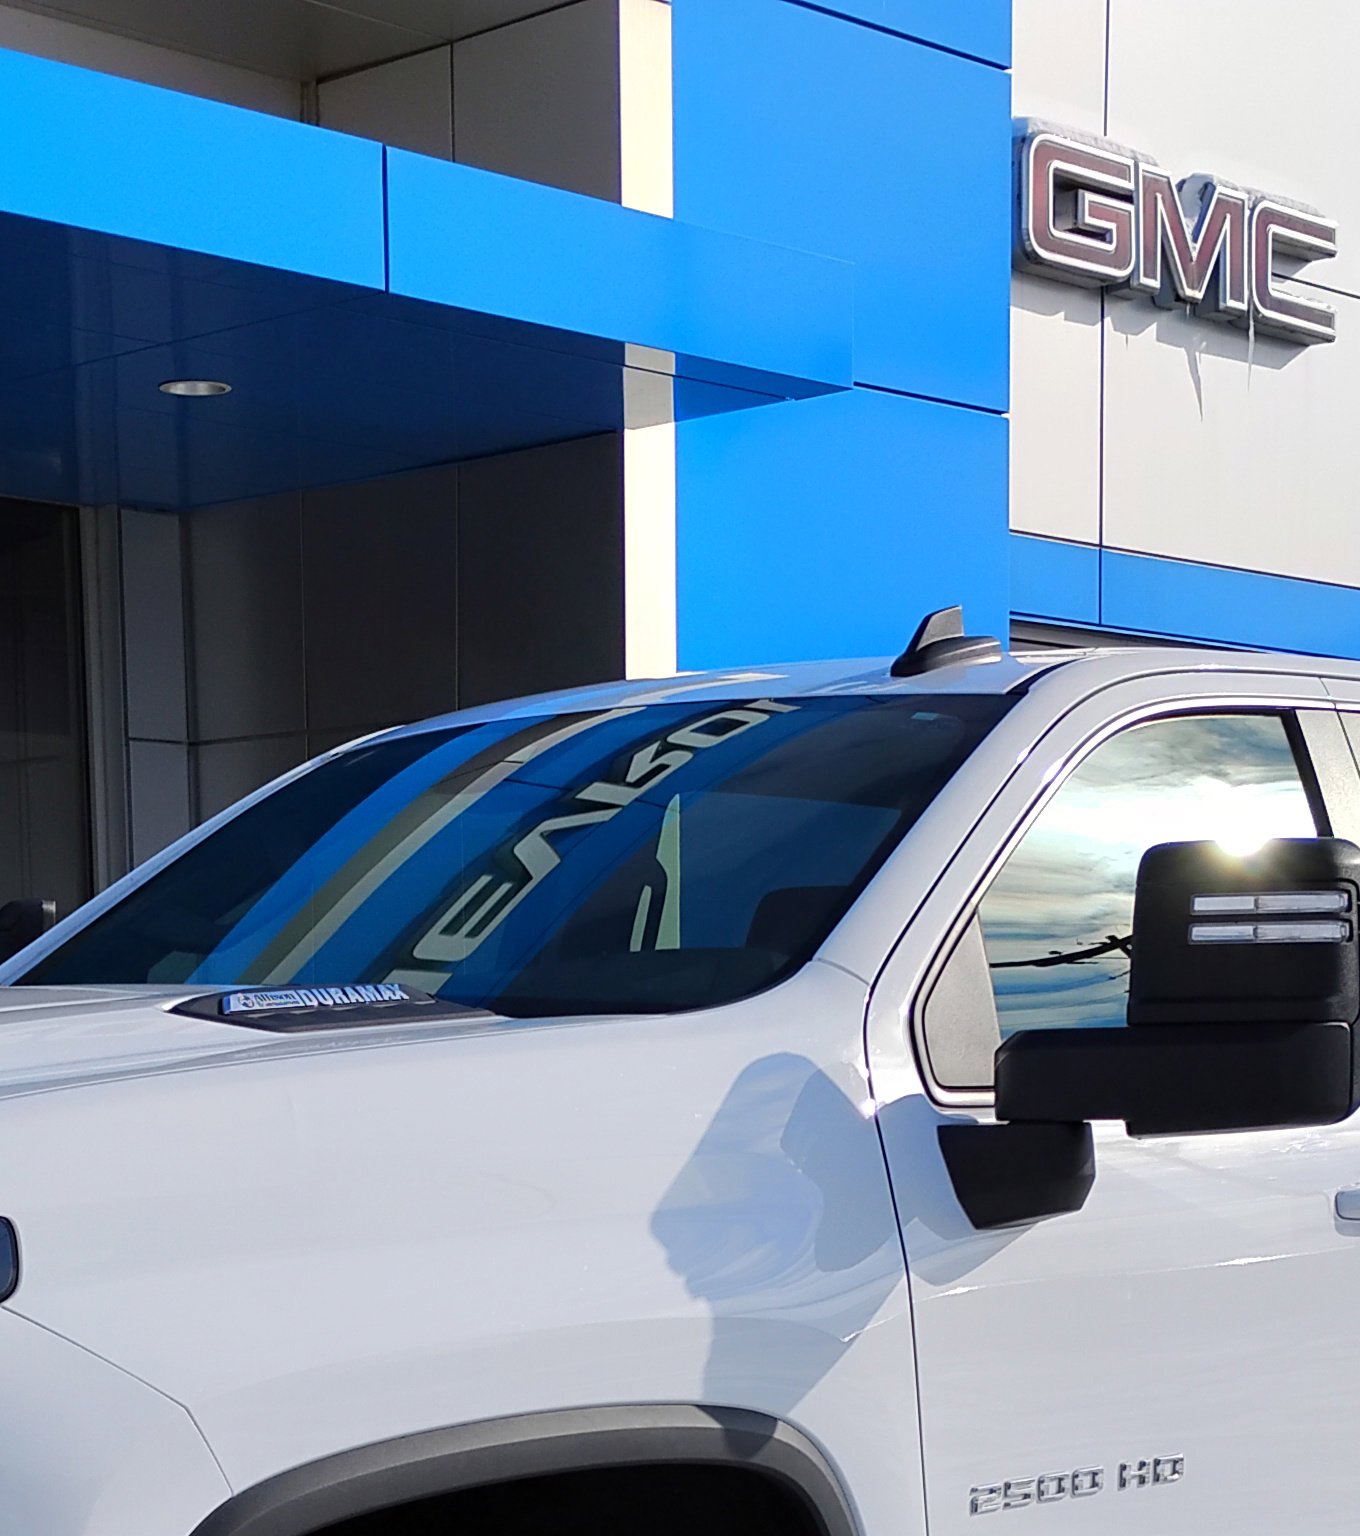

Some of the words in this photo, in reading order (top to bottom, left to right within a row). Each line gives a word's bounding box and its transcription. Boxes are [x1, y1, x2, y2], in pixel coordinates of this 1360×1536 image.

[1026, 132, 1339, 343] GMC
[296, 983, 410, 1008] DURAMAX
[968, 1463, 1105, 1517] 2500
[1117, 1452, 1185, 1491] HD
